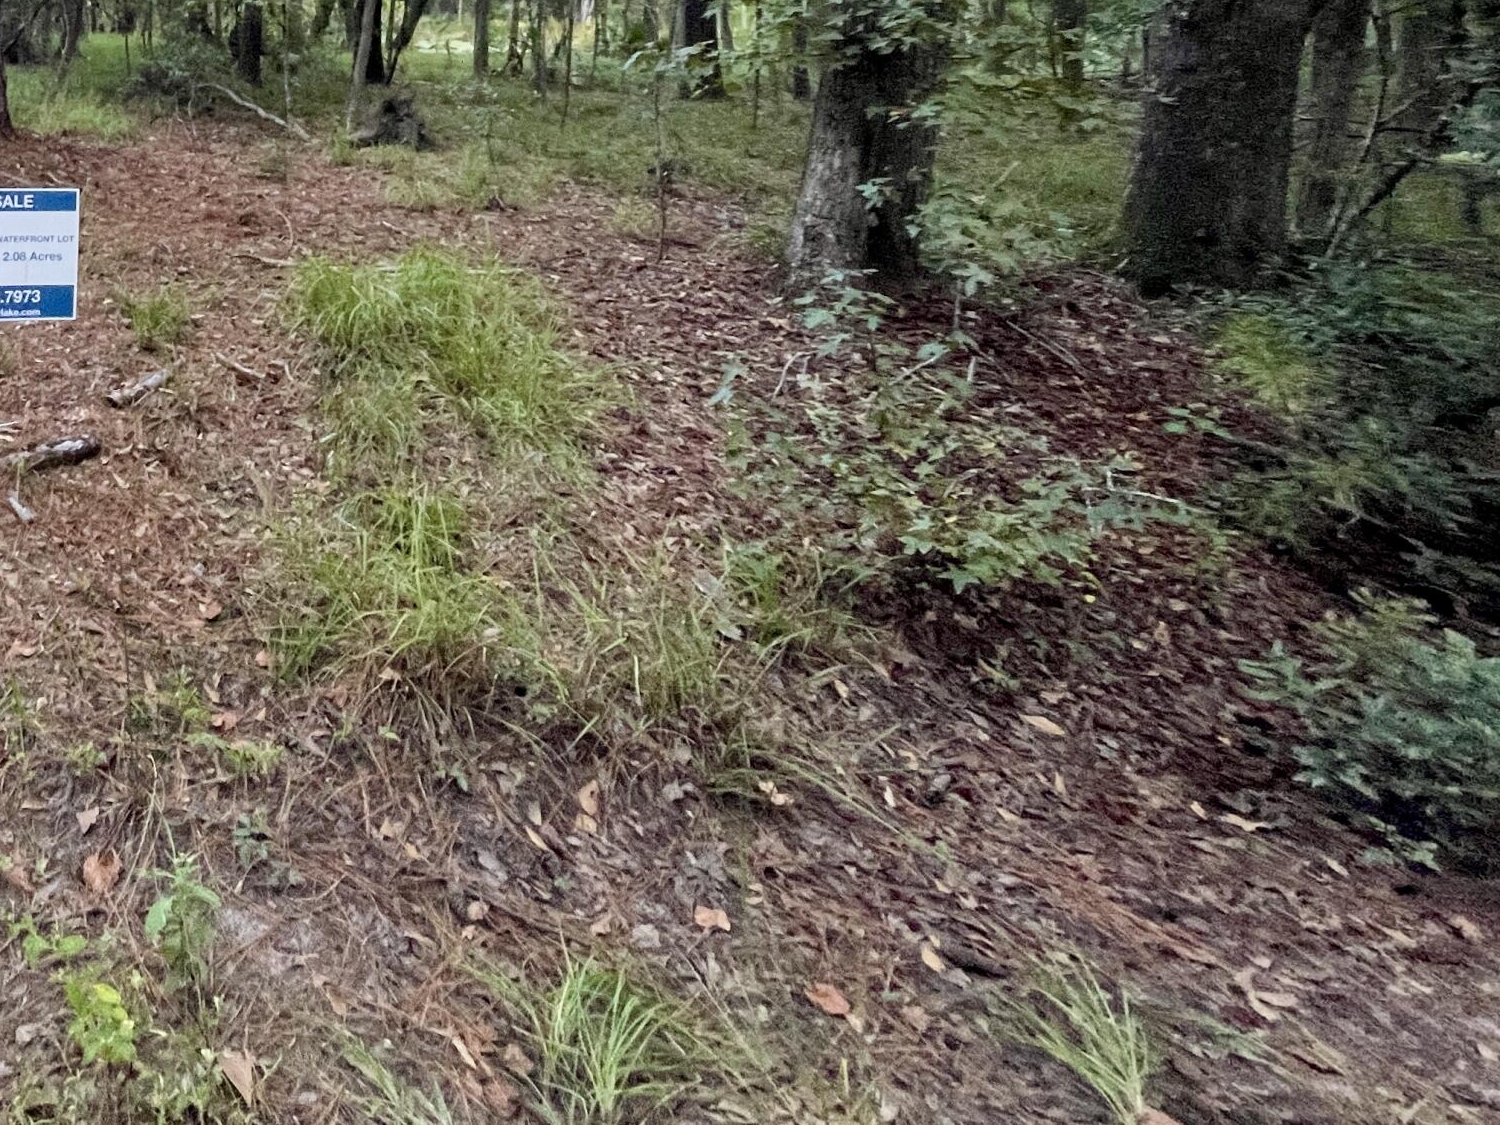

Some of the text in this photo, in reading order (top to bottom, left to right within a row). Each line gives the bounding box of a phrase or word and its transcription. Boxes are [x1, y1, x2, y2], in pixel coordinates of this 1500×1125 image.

[57, 235, 75, 243] LOT
[2, 251, 63, 262] 2.08 Acres
